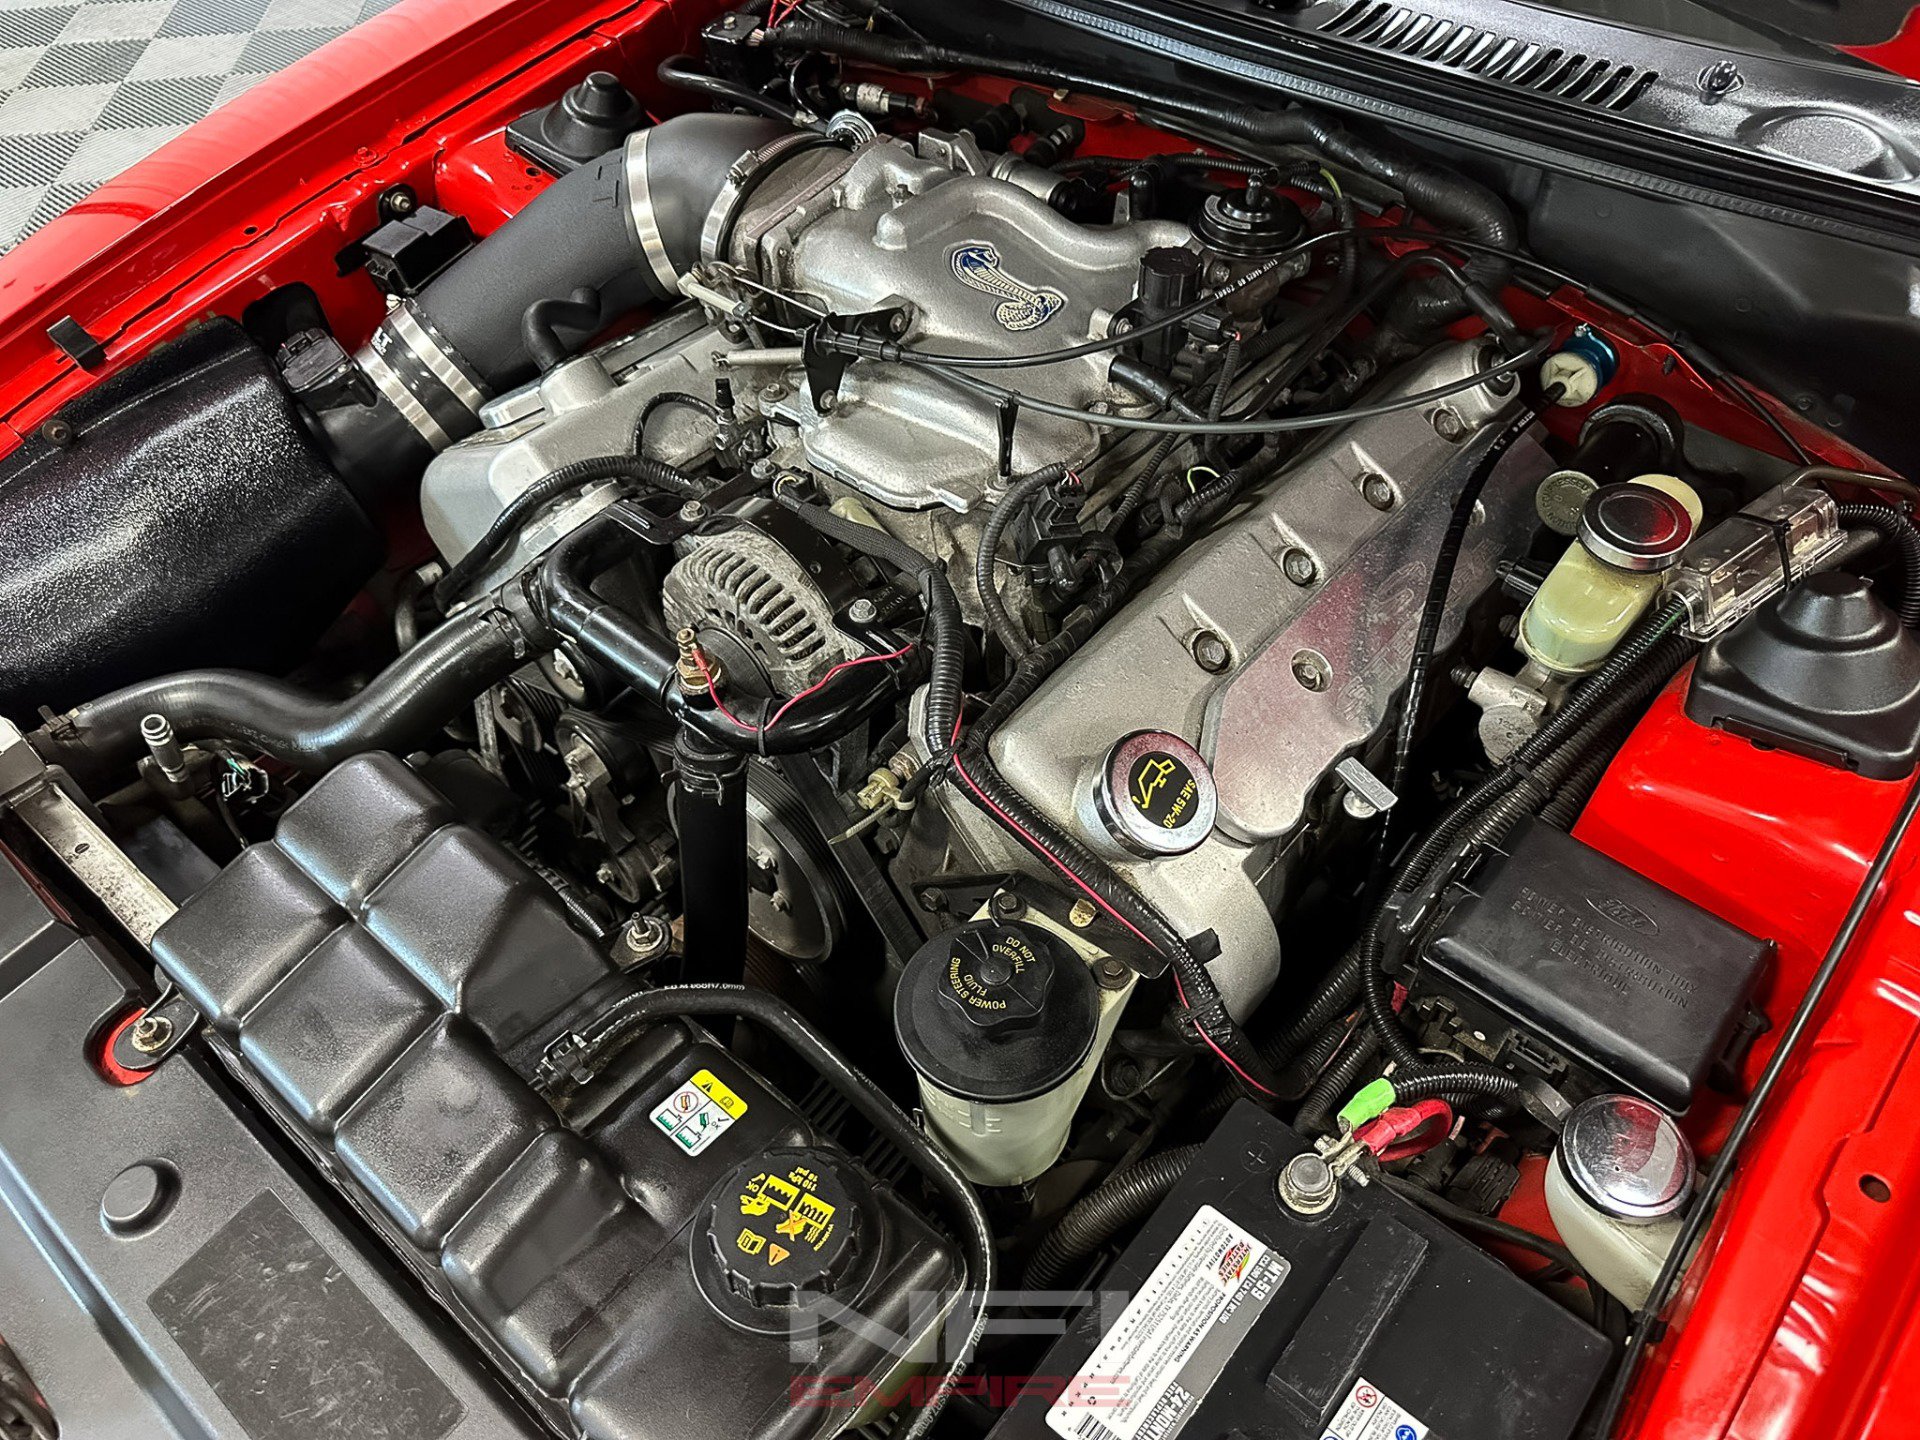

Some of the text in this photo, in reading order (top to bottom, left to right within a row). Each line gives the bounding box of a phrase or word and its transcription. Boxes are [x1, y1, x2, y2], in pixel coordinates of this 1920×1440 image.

[1162, 778, 1196, 829] SAE 5W-20
[1521, 886, 1566, 917] POWER
[1005, 936, 1036, 963] DO NOT
[1570, 933, 1590, 951] DE
[991, 943, 1026, 974] OVERFILL
[949, 957, 1007, 1010] POWER STEERING
[963, 974, 988, 997] FLUID
[794, 1166, 810, 1177] psi
[745, 1180, 760, 1193] OK
[802, 1179, 818, 1192] 110
[1205, 1233, 1234, 1270] AUTOMOTIVE
[1217, 1241, 1245, 1277] BATTERIES
[1221, 1243, 1252, 1283] INTERSTATE
[1257, 1253, 1271, 1268] CCA
[1234, 1286, 1247, 1301] 740
[1241, 1279, 1253, 1291] CA
[1249, 1259, 1285, 1301] MT-59
[1197, 1291, 1226, 1329] PROPOSITION
[1217, 1309, 1231, 1324] 100
[1225, 1301, 1237, 1313] RC
[1173, 1334, 1195, 1363] WARNING
